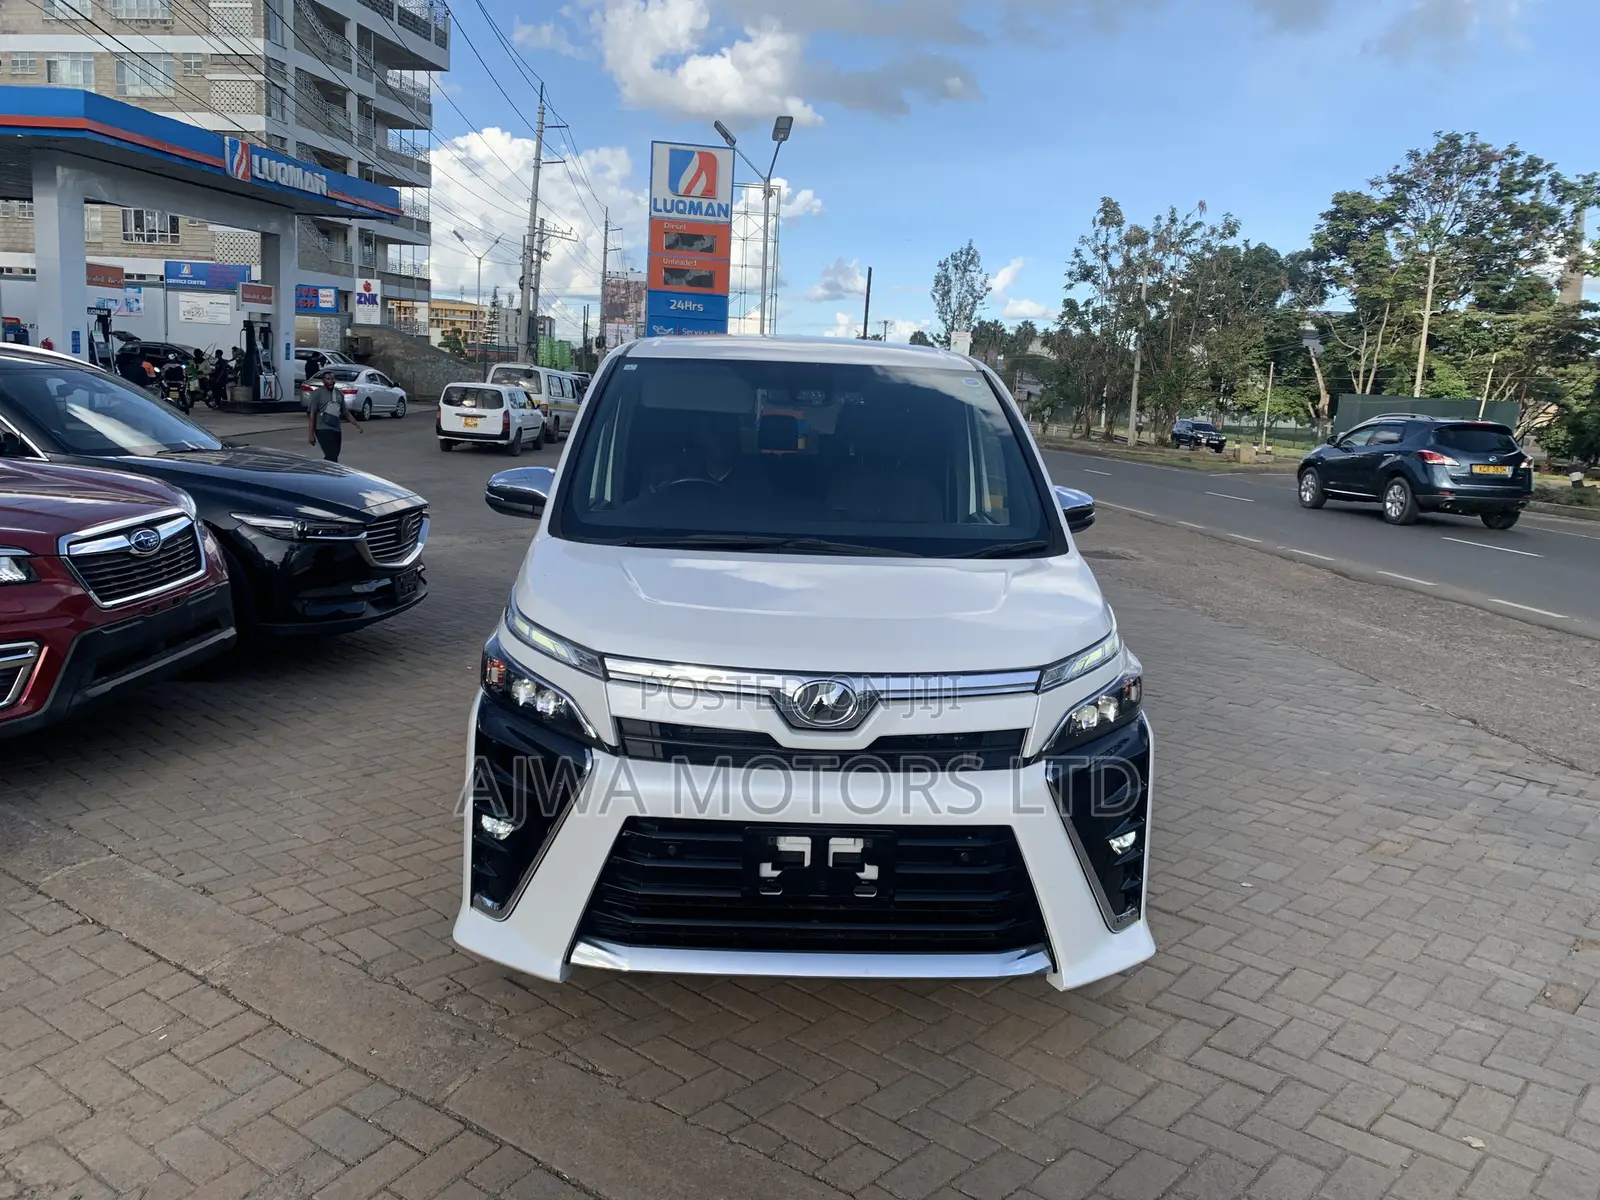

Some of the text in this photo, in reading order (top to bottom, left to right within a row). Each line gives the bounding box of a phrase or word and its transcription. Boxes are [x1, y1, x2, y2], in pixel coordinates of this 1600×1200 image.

[252, 154, 327, 196] LUQMAN
[653, 198, 730, 218] LUQMAN
[664, 222, 686, 230] Diesel
[663, 258, 697, 266] Unleaded
[356, 292, 379, 306] ZNK
[669, 299, 704, 312] 24Hrs
